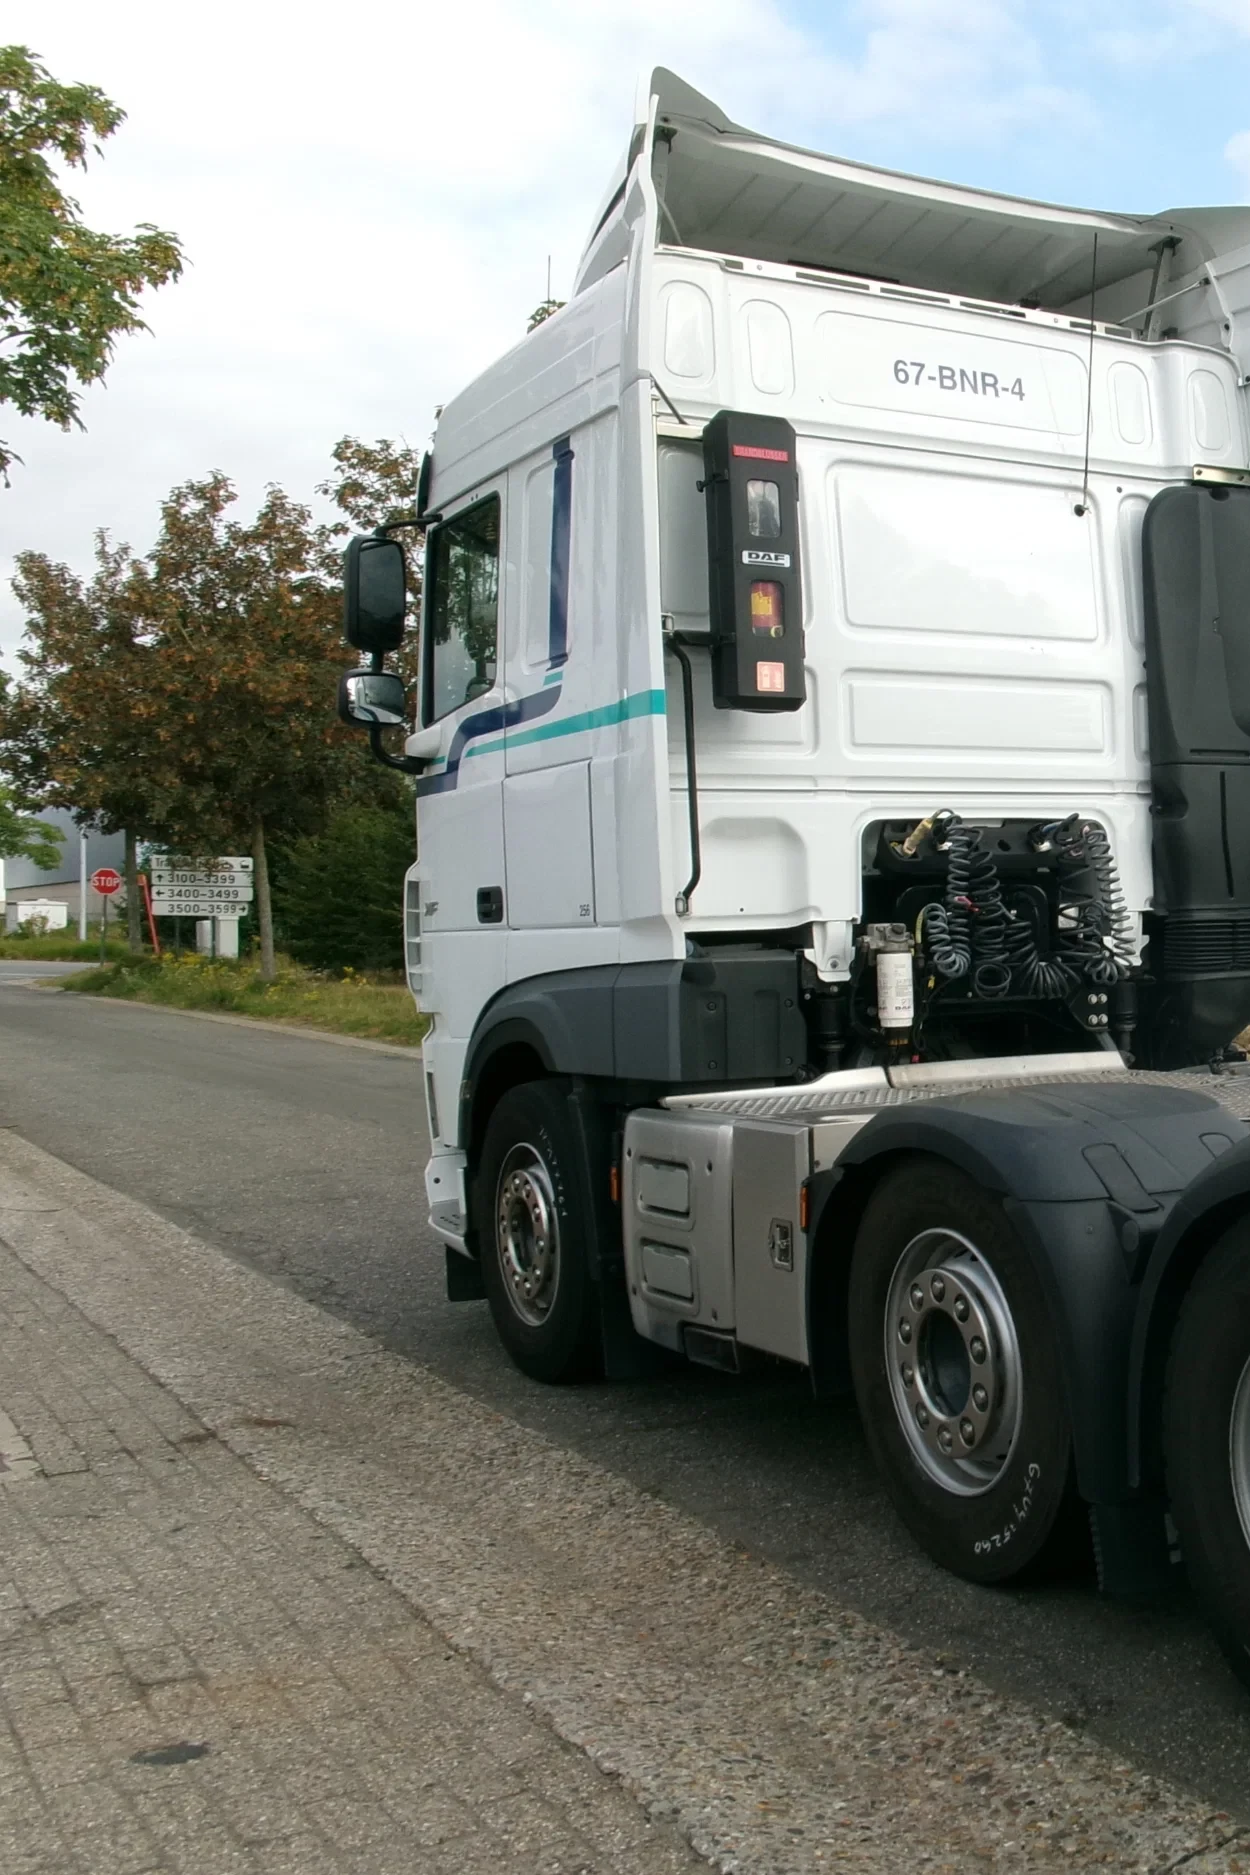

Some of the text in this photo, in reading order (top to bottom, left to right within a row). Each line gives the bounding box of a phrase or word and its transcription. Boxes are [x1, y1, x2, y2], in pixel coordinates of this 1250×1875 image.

[893, 359, 1026, 401] 67-BNR-4
[748, 552, 785, 561] DAF
[93, 876, 120, 887] STOP
[168, 873, 236, 884] 3100-3399
[168, 889, 239, 899] 3400-3499
[168, 903, 237, 914] 3500-3599
